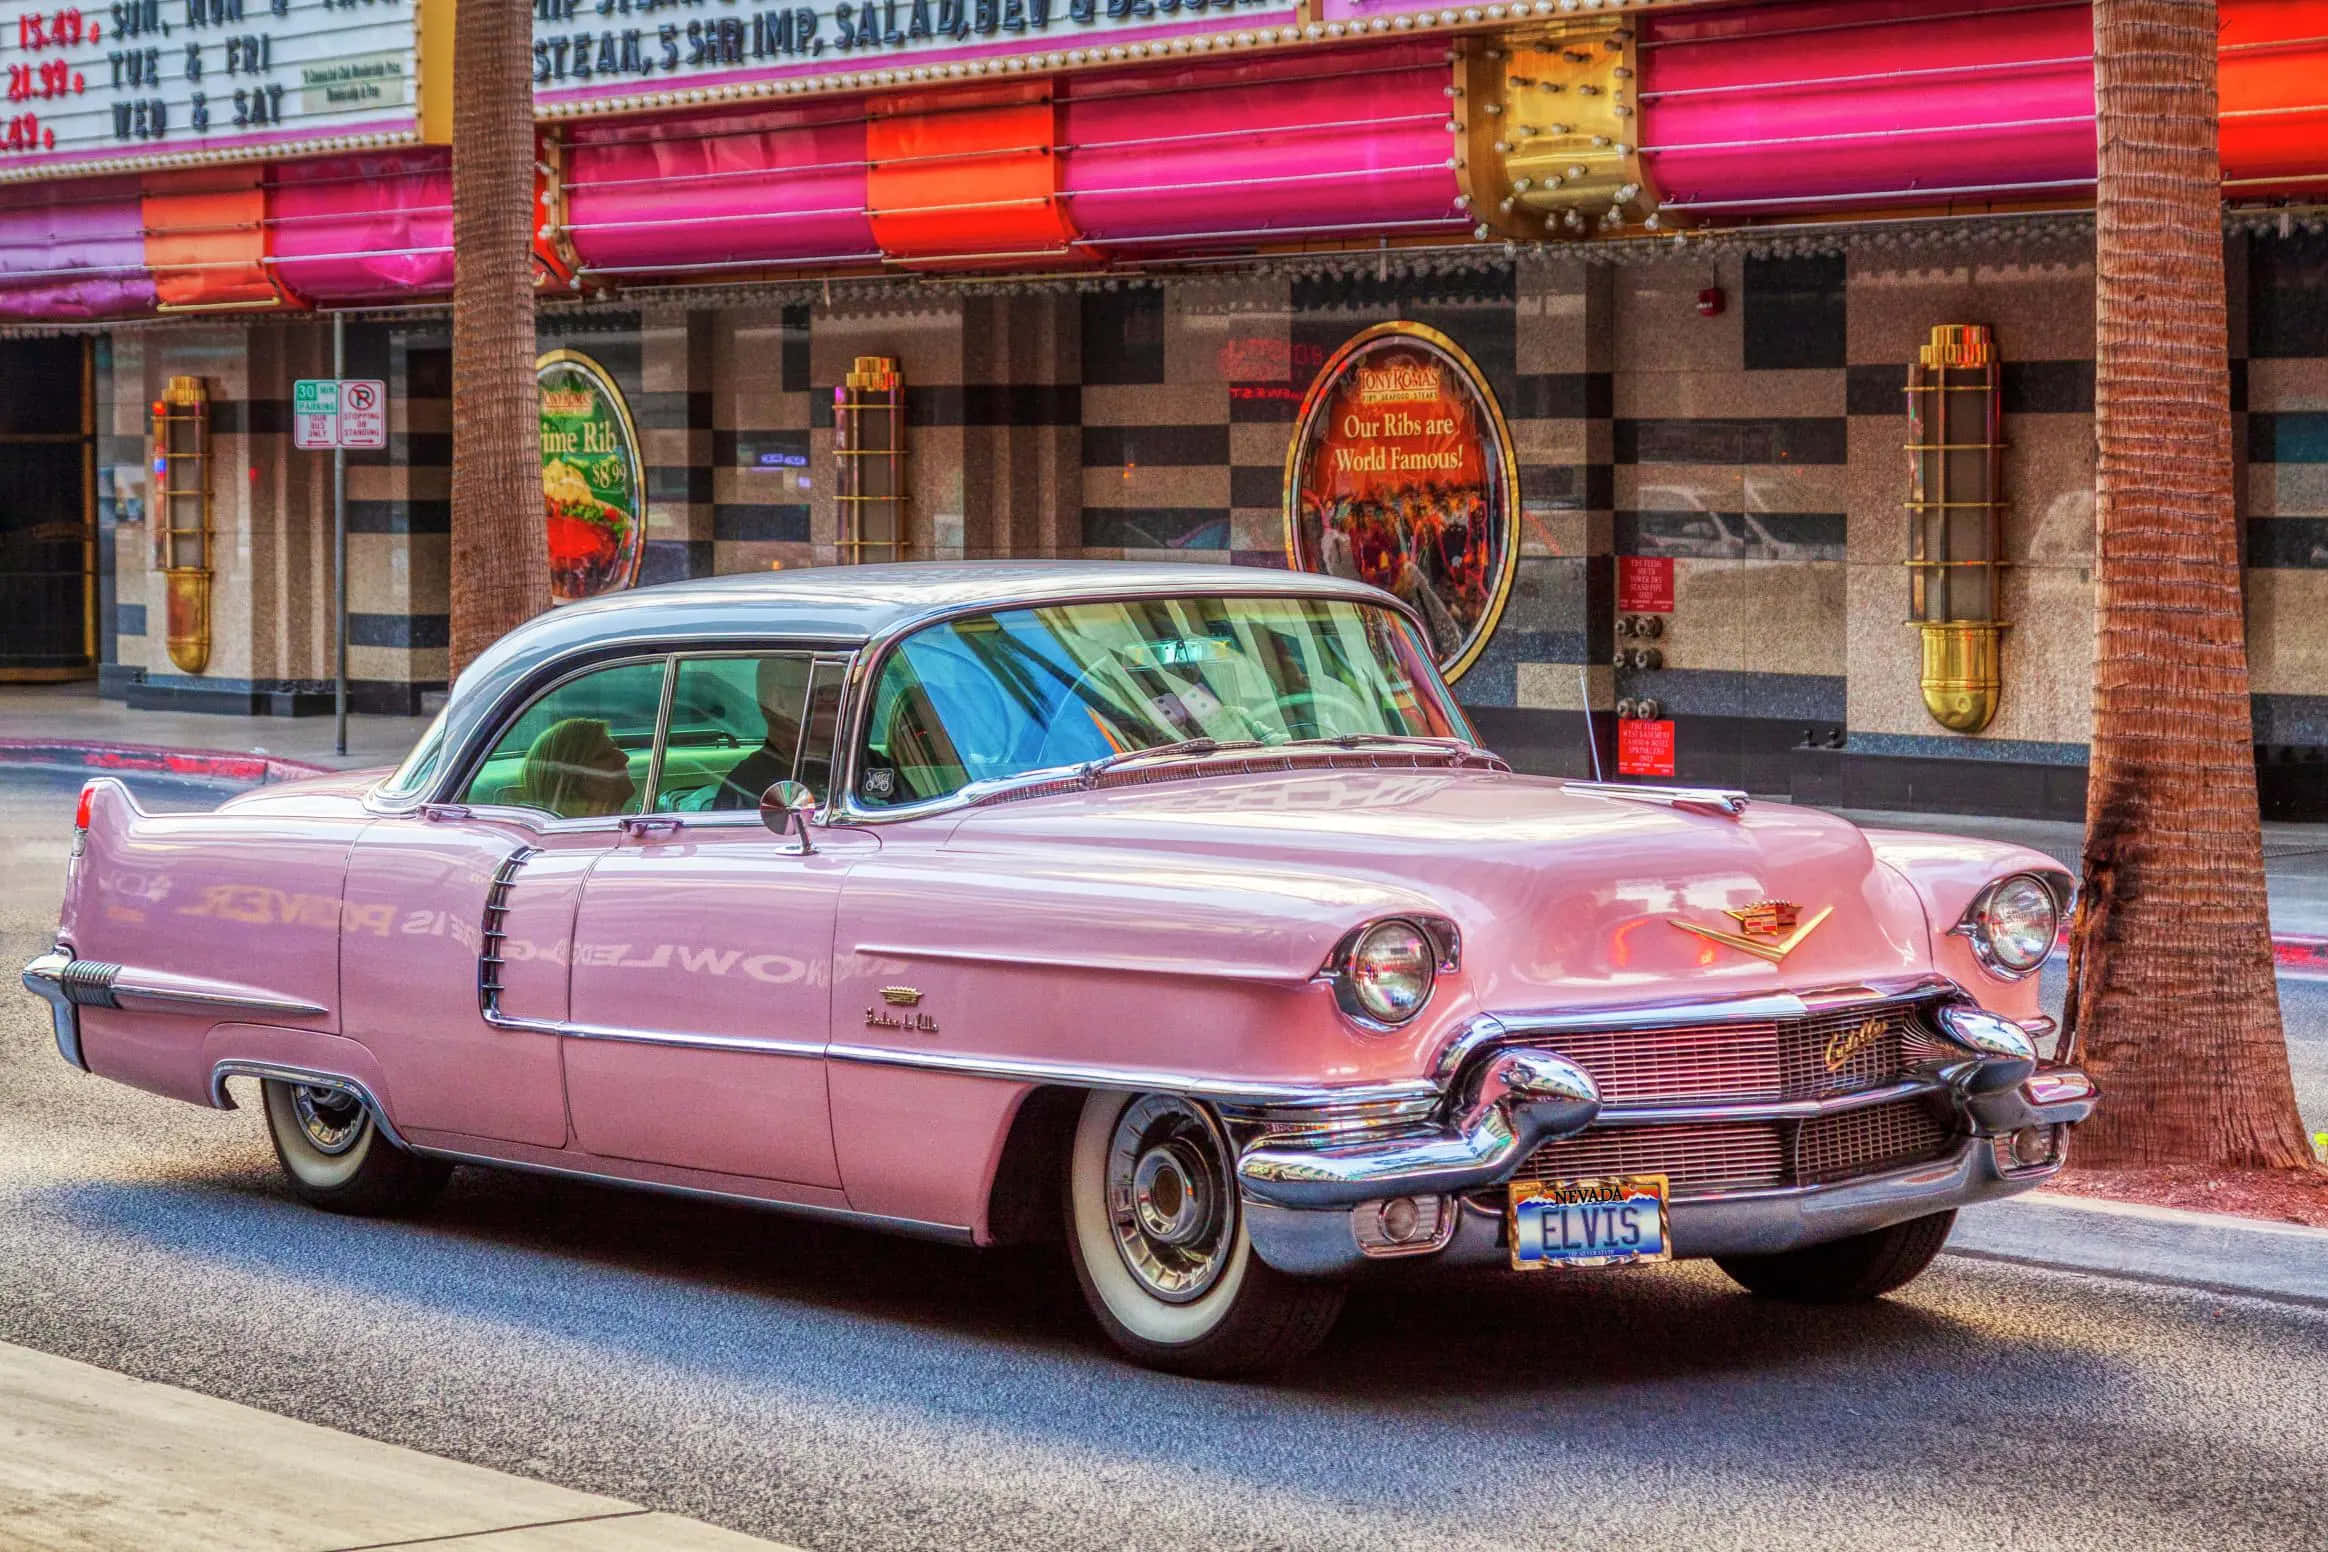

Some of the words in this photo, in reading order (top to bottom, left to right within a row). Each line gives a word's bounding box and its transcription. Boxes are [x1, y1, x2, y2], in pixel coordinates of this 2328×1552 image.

[108, 47, 159, 88] TUE
[226, 33, 270, 75] FRI
[533, 31, 652, 83] STEAK,
[658, 23, 679, 70] 5
[687, 7, 825, 66] SHRIMP,
[112, 97, 167, 139] WED
[232, 83, 283, 126] SAT
[298, 384, 315, 400] 30
[583, 420, 617, 454] Rib
[1344, 414, 1381, 438] Our
[1384, 411, 1422, 436] Ribs
[1426, 418, 1454, 435] are
[1335, 446, 1386, 473] World
[1391, 443, 1464, 470] Famous!
[1554, 1188, 1624, 1204] NEVADA
[1541, 1206, 1640, 1250] ELVIS
